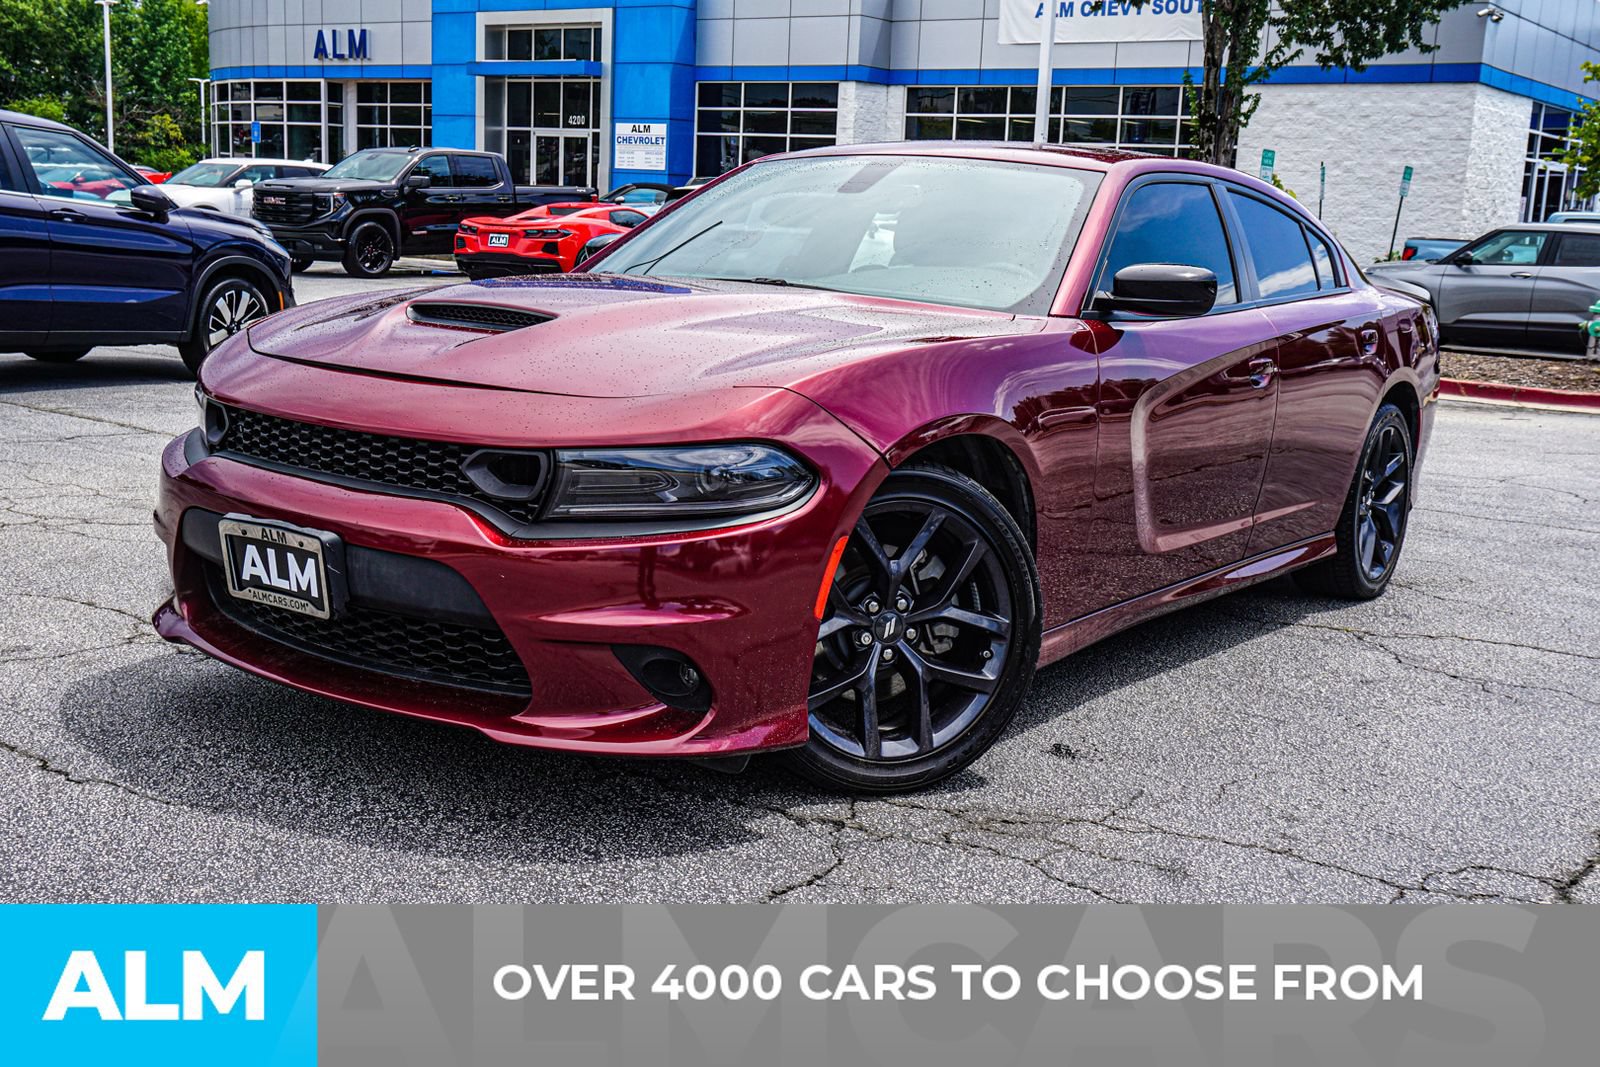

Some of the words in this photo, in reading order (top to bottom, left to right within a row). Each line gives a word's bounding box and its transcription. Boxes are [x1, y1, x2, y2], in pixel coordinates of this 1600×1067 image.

[1035, 2, 1074, 18] AM
[313, 29, 367, 59] ALM
[568, 115, 586, 125] 4200
[631, 124, 651, 133] ALM
[616, 135, 665, 144] CHEVROLET
[490, 236, 507, 245] ALM
[261, 527, 287, 545] ALM
[242, 544, 318, 598] ALM
